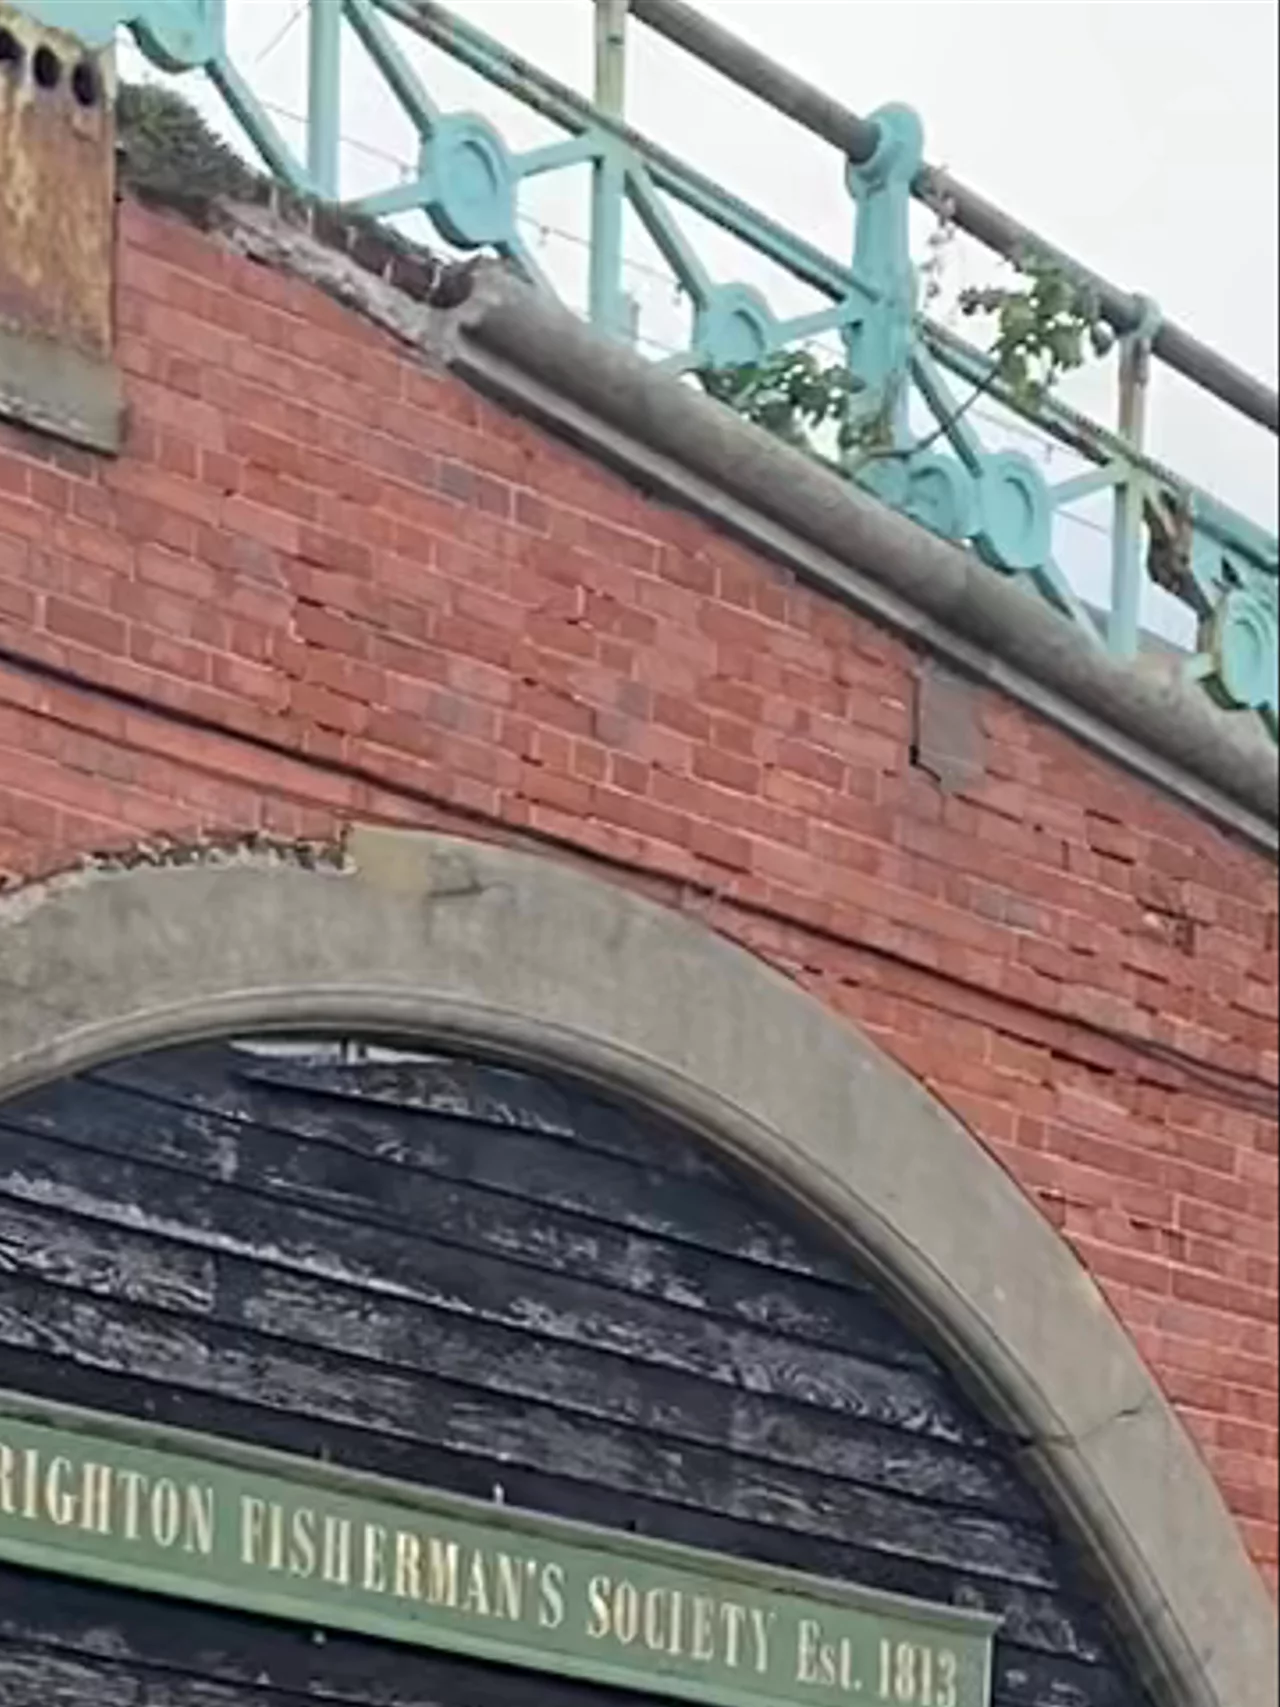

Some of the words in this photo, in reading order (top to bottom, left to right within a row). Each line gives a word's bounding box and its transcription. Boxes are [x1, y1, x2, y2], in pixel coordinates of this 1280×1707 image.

[240, 1496, 565, 1628] FISHERMAN'S
[587, 1574, 776, 1673] SOCIETY
[796, 1619, 861, 1691] Est.
